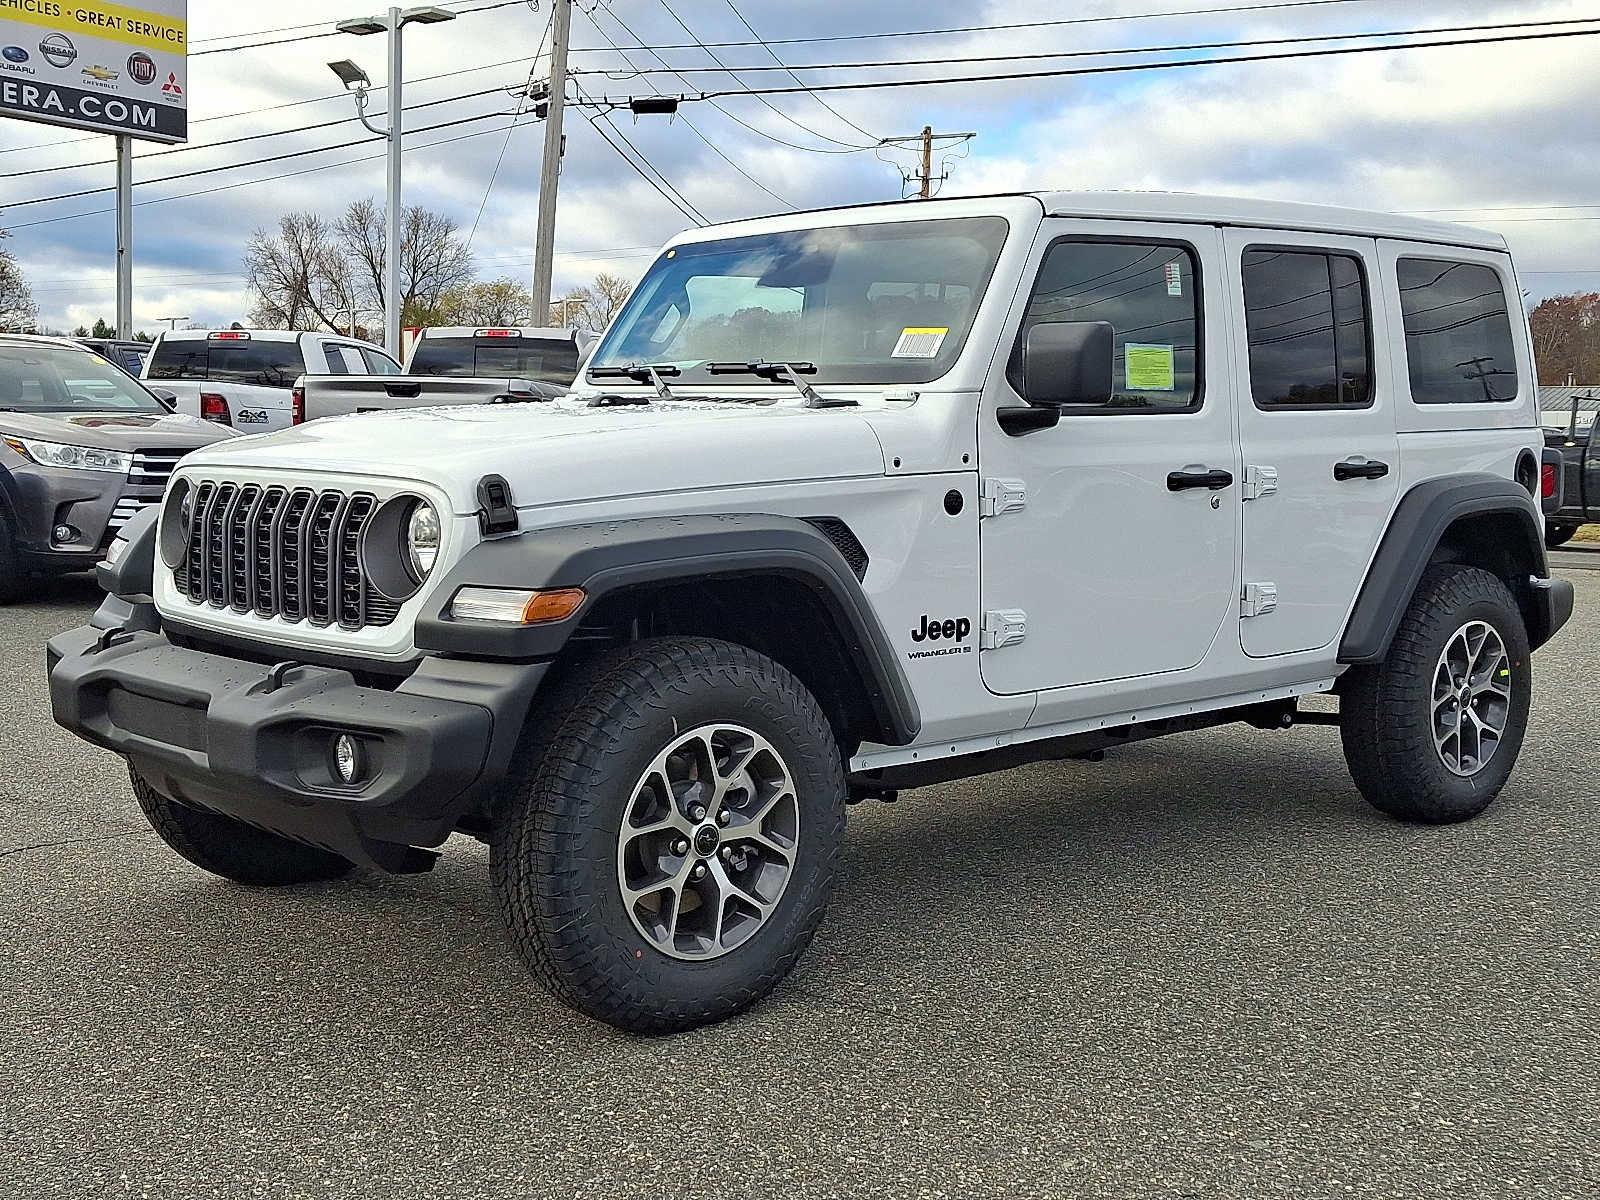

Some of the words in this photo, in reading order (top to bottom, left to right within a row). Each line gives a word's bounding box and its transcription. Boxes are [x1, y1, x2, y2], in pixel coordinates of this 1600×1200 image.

[75, 9, 122, 30] GREAT
[126, 20, 184, 43] SERVICE
[42, 44, 74, 57] NISSAN
[134, 61, 151, 77] FIAT
[82, 79, 119, 90] CHEVROLET
[3, 81, 157, 128] ERA.COM
[911, 614, 971, 643] Jeep
[907, 647, 962, 660] WRANGLER
